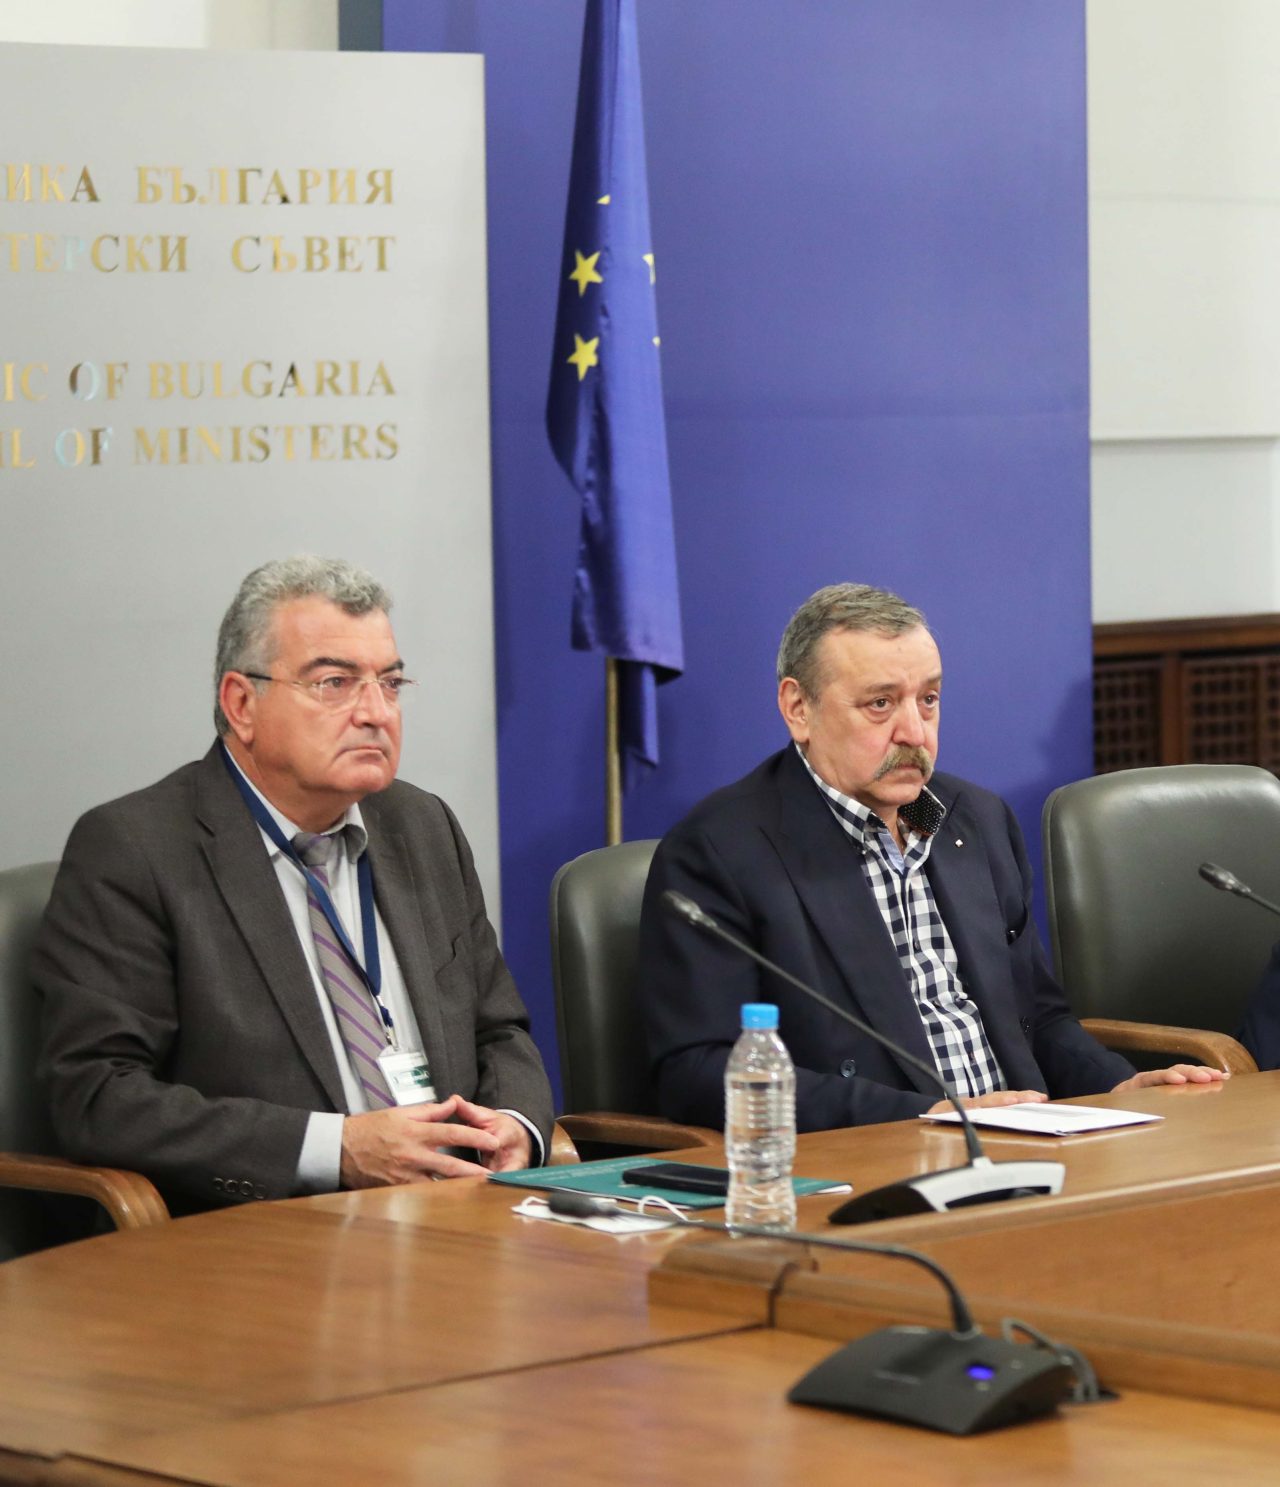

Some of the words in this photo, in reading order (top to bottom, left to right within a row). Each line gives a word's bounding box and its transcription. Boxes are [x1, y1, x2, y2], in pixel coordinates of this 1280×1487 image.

[3, 164, 101, 202] ИКА
[135, 167, 394, 204] БЪЛГАРИЯ
[0, 233, 188, 273] ТЕРСКИ
[230, 235, 396, 273] СЪВЕТ
[4, 362, 49, 402] IC
[69, 361, 128, 401] OF
[149, 361, 396, 400] BULGARIA
[55, 427, 113, 467] OF
[133, 424, 398, 466] MINISTERS
